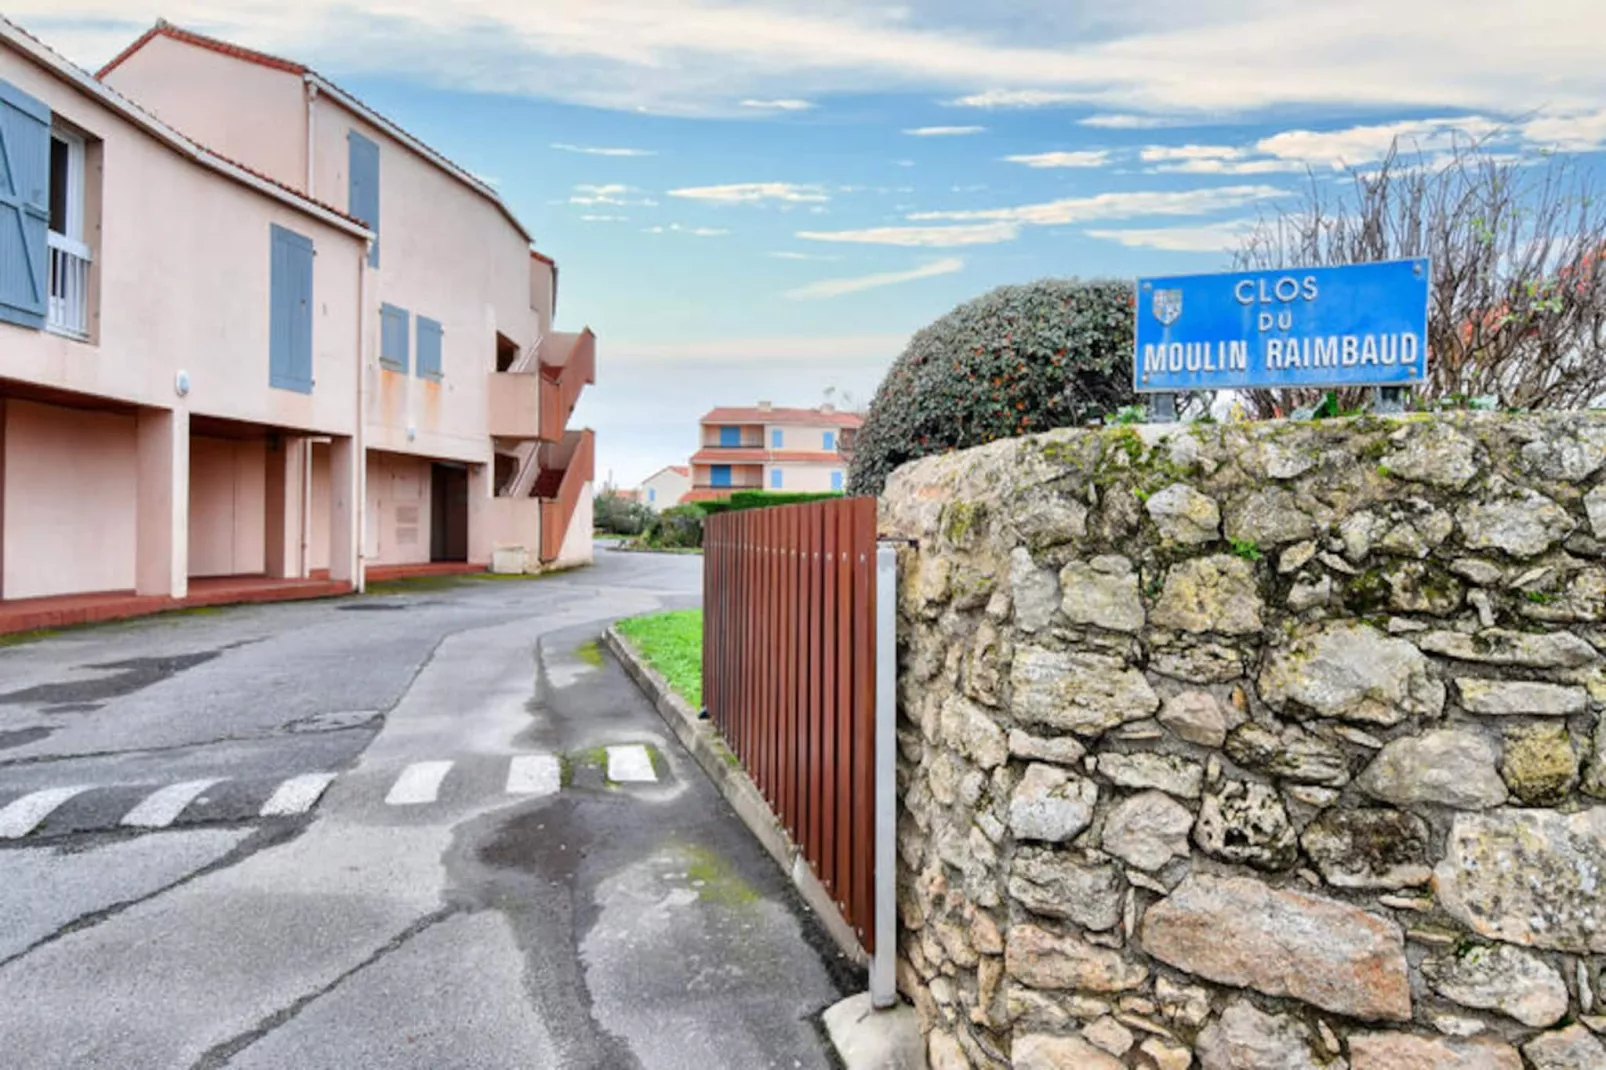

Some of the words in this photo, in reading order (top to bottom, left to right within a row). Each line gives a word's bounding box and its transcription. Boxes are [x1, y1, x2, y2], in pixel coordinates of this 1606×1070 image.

[1235, 276, 1319, 304] CLOS
[1258, 311, 1293, 332] DU
[1143, 340, 1248, 373] MOULIN
[1265, 332, 1418, 370] RAIMBAUD
